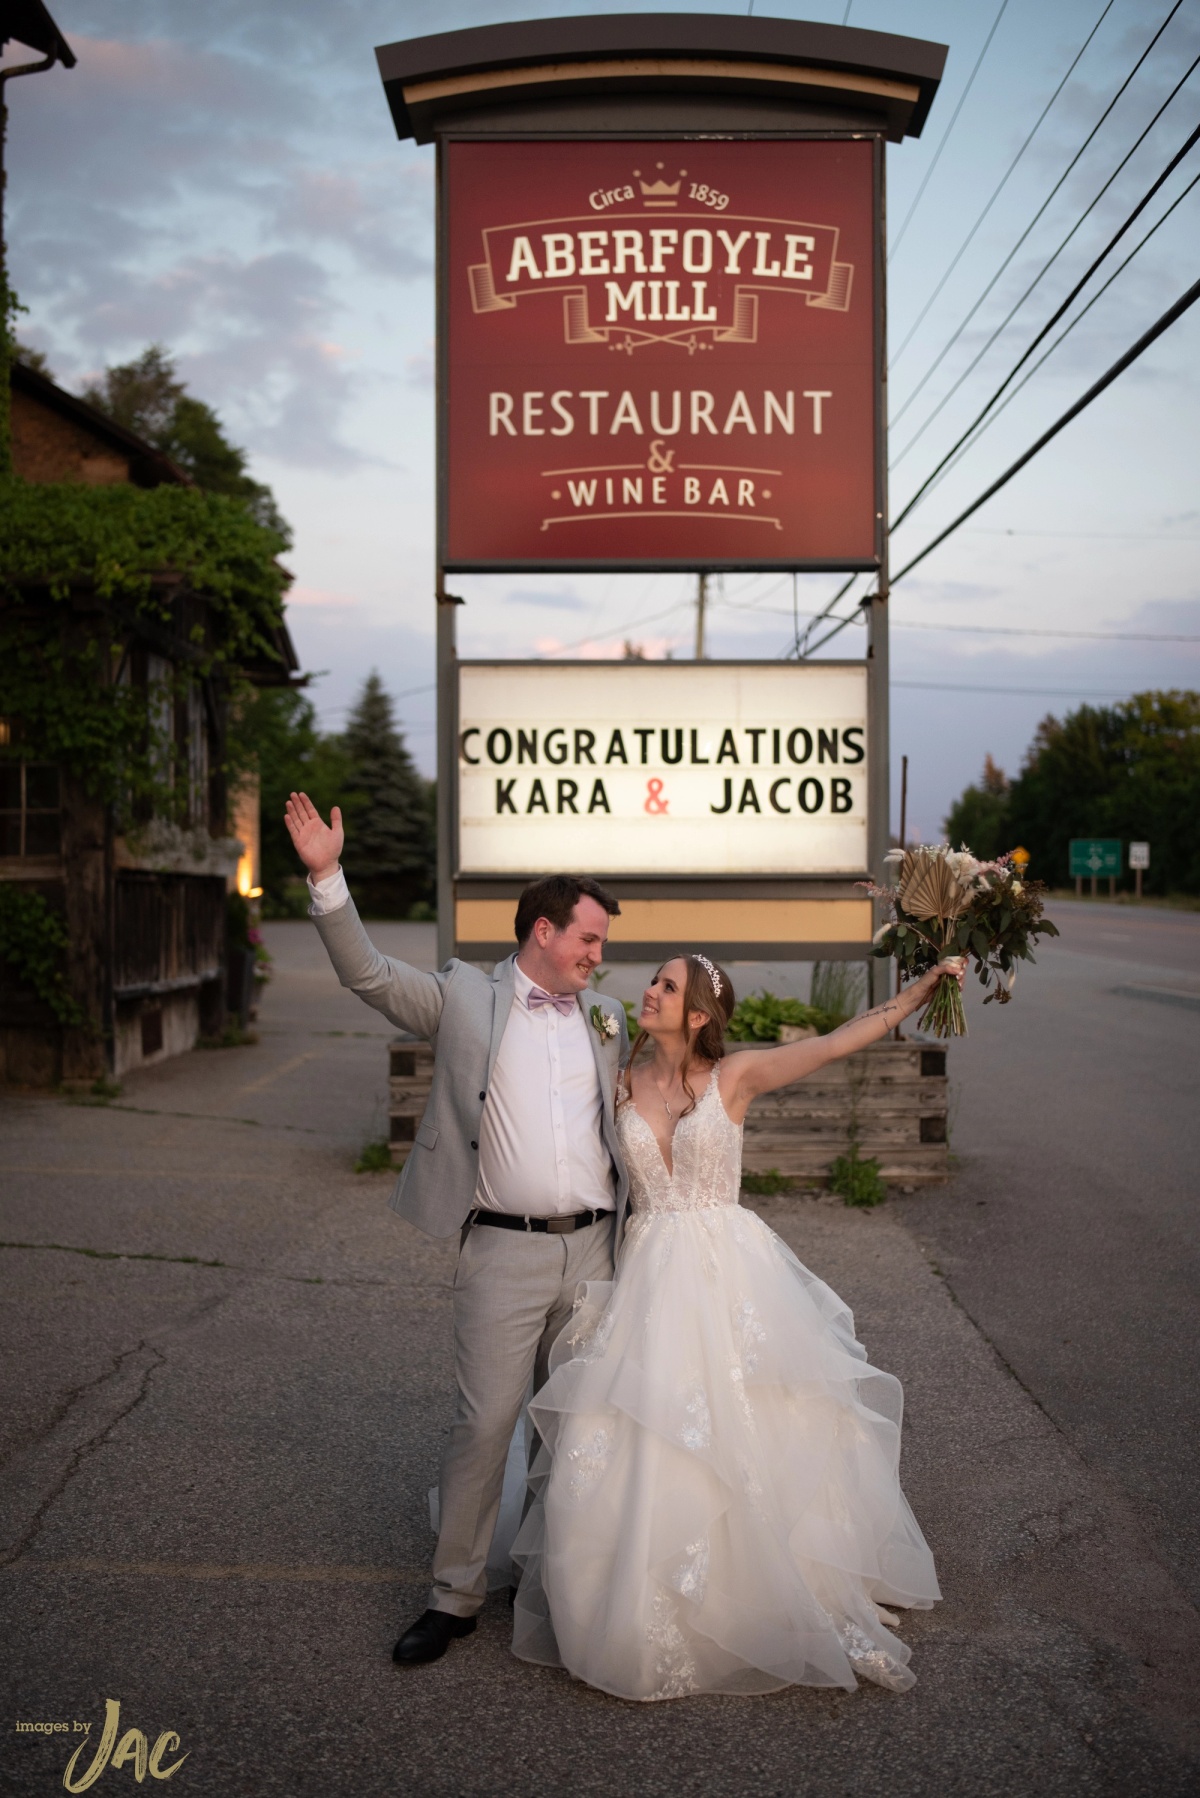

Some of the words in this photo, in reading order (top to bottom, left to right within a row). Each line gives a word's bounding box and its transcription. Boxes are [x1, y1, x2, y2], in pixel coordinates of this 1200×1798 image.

[588, 183, 635, 211] Circa
[688, 182, 730, 211] 1859
[505, 228, 816, 282] ABERFOYLE
[604, 281, 718, 322] MILL
[488, 390, 833, 437] RESTAURANT
[646, 439, 676, 474] &
[566, 476, 668, 507] WINE
[684, 476, 757, 507] BAR
[459, 727, 866, 766] CONGRATULATIONS
[495, 777, 612, 815] KARA
[643, 777, 670, 816] &
[710, 776, 854, 815] JACOB
